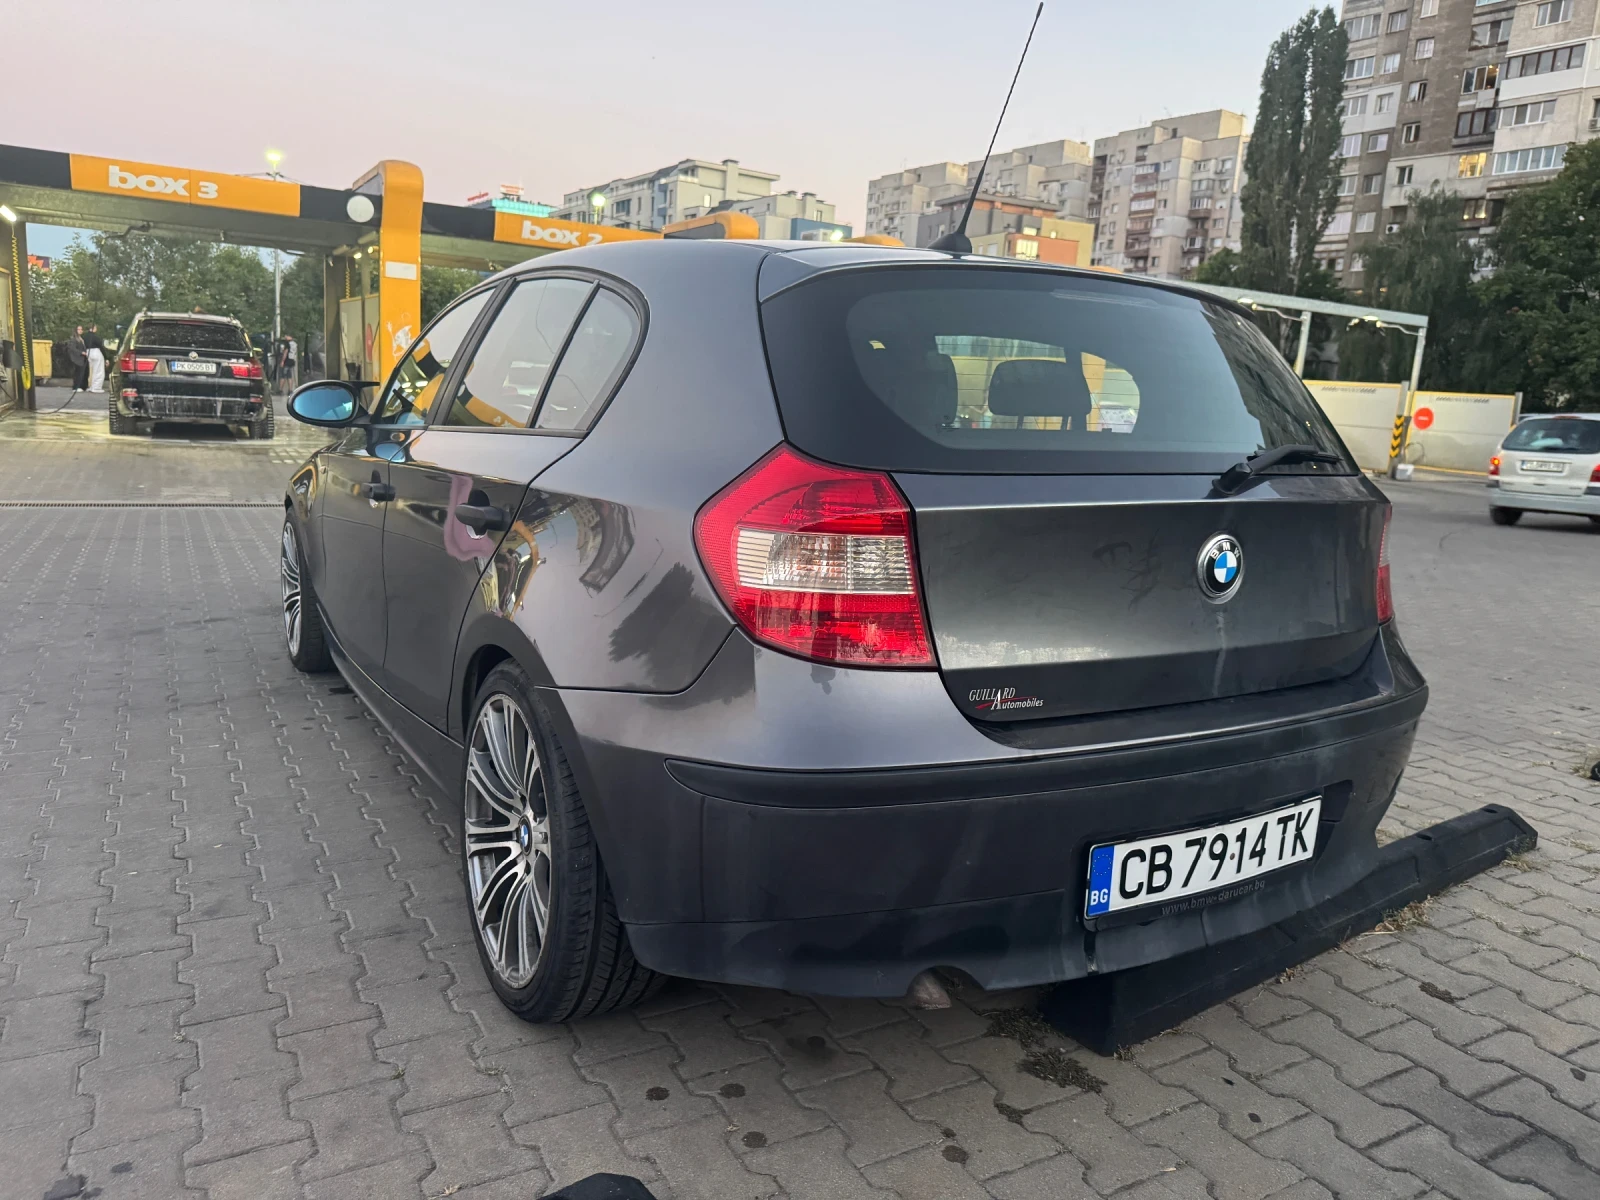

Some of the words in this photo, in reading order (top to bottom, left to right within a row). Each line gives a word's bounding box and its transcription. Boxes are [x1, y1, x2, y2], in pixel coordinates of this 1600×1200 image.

[108, 165, 190, 197] box
[197, 181, 218, 199] 3
[521, 220, 582, 246] box
[586, 233, 603, 246] 2
[1210, 541, 1240, 560] BMW
[969, 687, 1016, 703] GUILLARD
[1119, 844, 1173, 900] CB
[1181, 822, 1268, 888] 7914
[1276, 807, 1314, 861] TK
[1090, 889, 1109, 906] BG
[1161, 878, 1266, 916] www.bmw-darucar.bg
